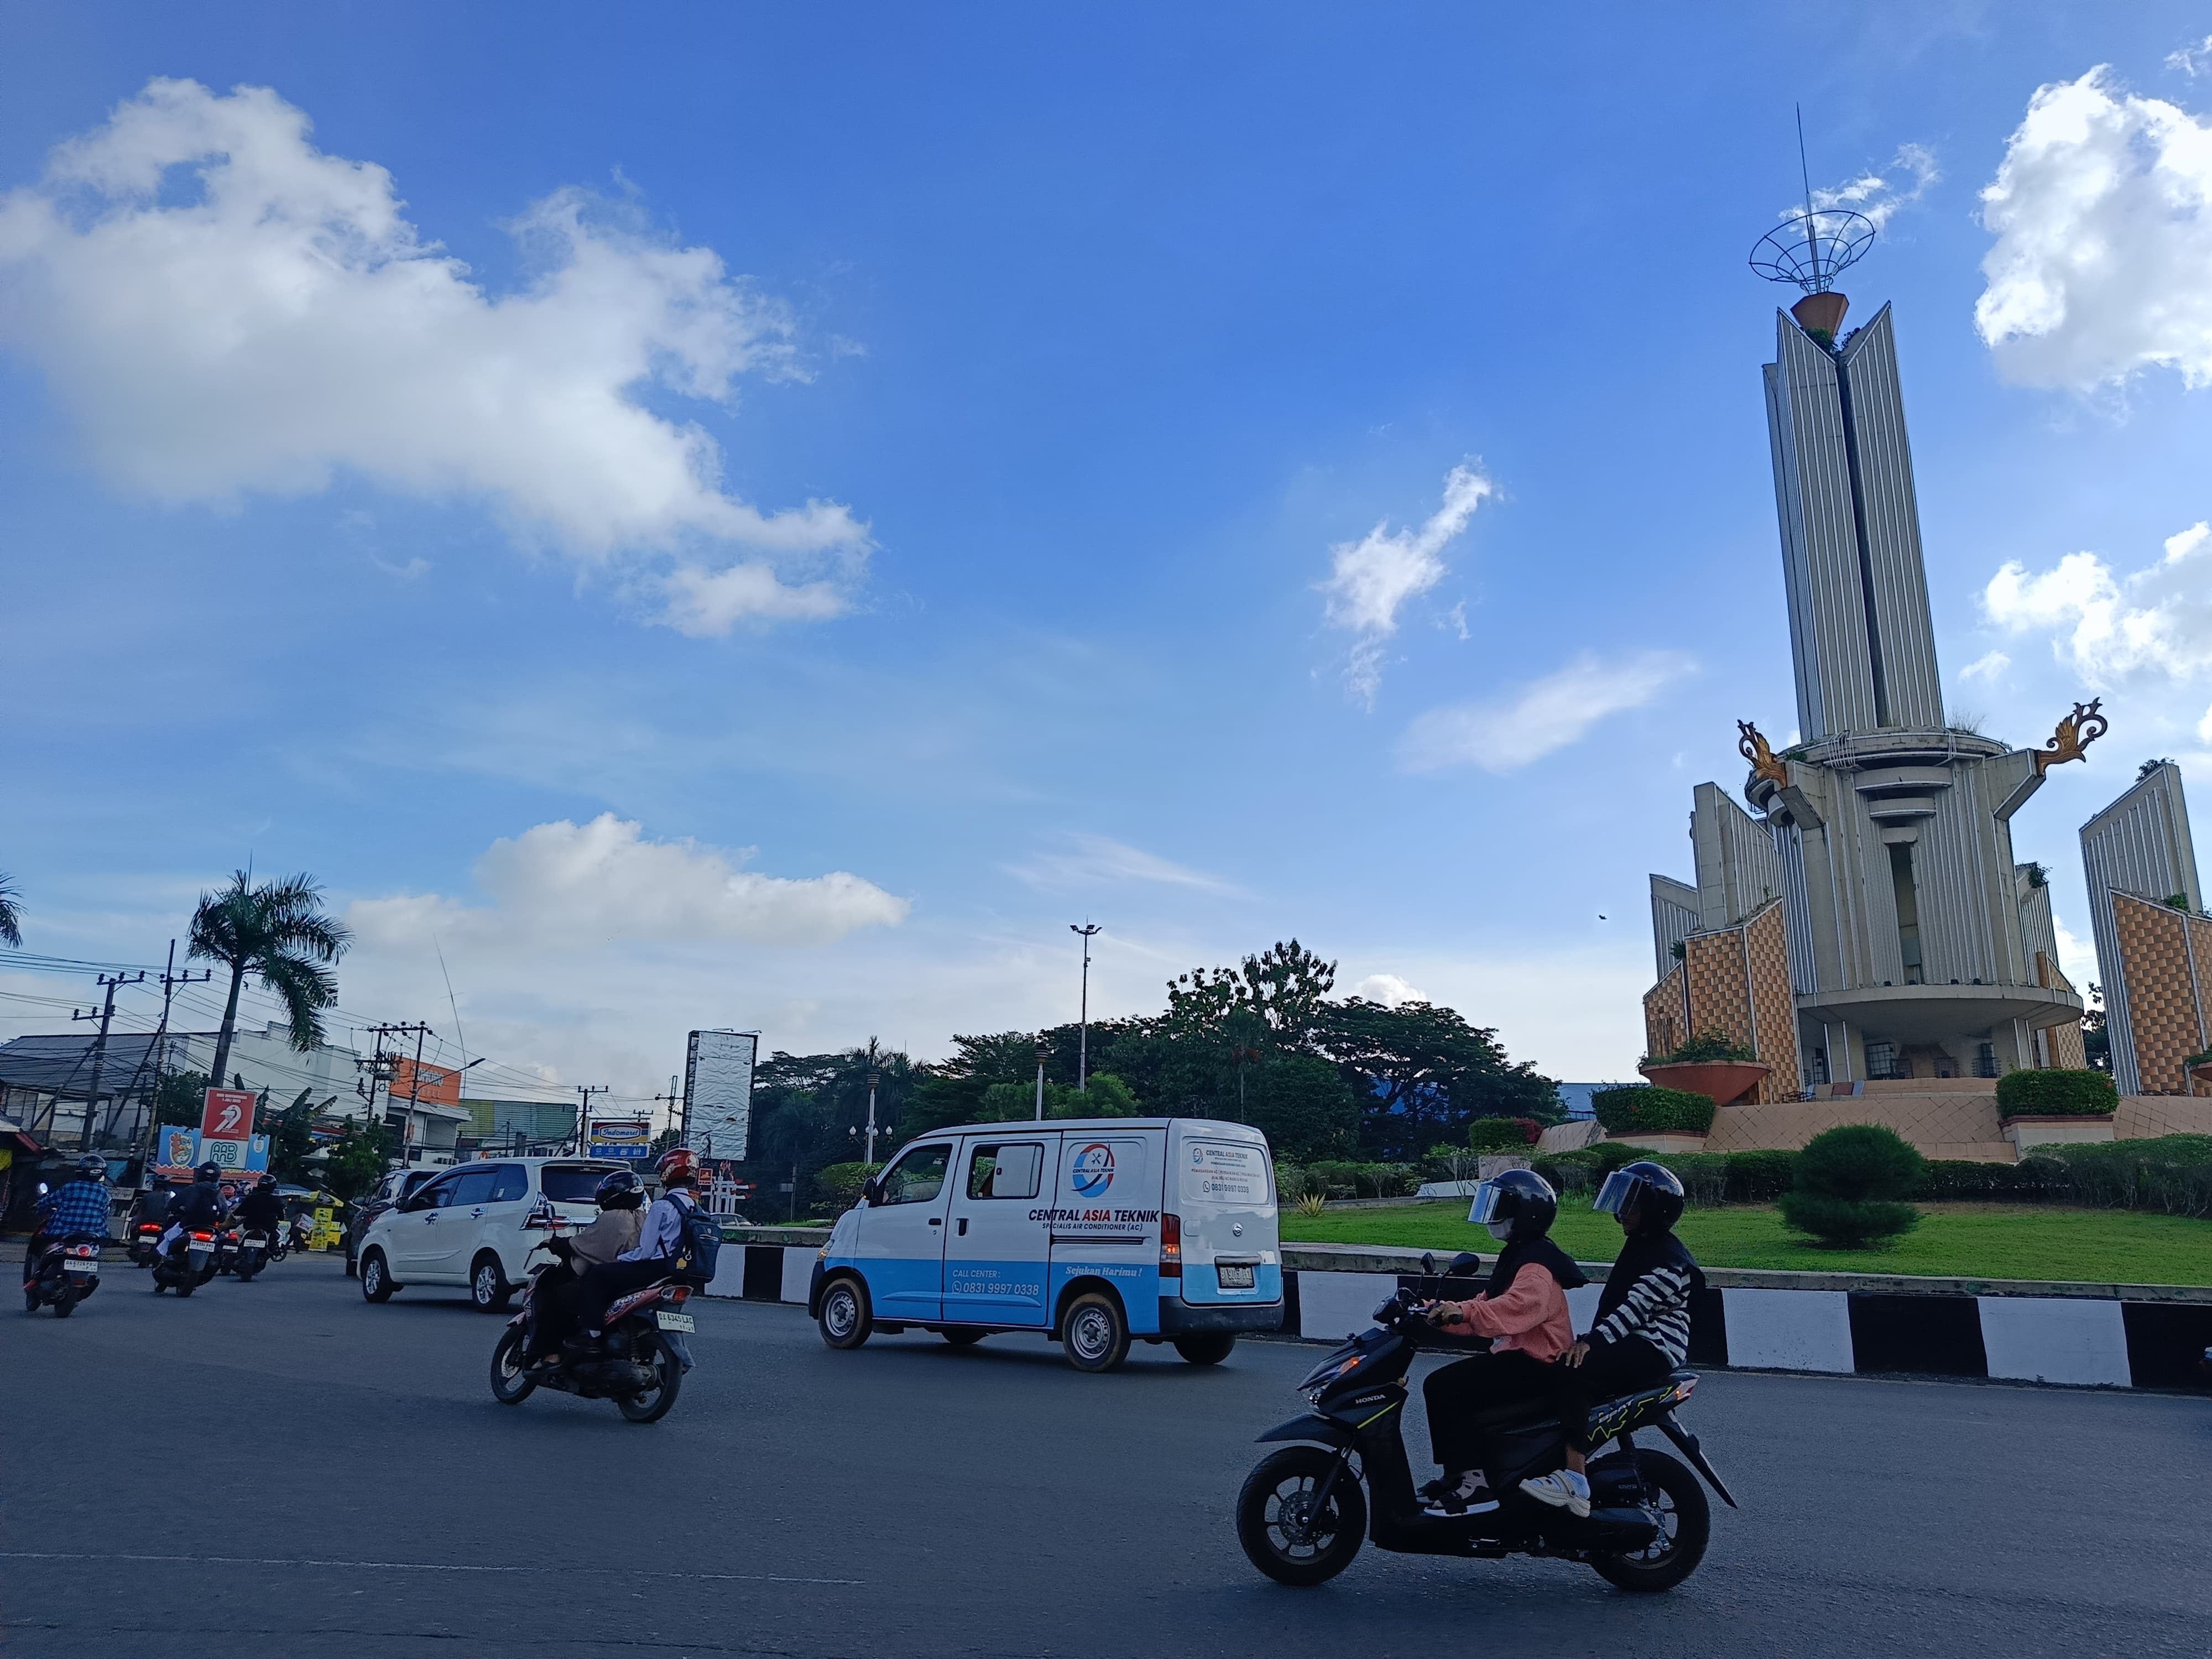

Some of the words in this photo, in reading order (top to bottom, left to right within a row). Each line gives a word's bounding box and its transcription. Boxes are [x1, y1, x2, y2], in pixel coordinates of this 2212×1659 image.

[1224, 1184, 1237, 1192] 9997
[1029, 1209, 1080, 1221] CENTRAL
[1082, 1209, 1110, 1221] ASIA
[1114, 1210, 1160, 1222] TEKNIK
[1127, 1223, 1143, 1232] (AC)
[952, 1269, 969, 1277] CALL
[1066, 1266, 1100, 1276] Sejukan
[1101, 1267, 1137, 1277] Harimu
[1220, 1269, 1225, 1279] B
[963, 1282, 985, 1293] 0831
[987, 1283, 1013, 1294] 9997
[1014, 1284, 1039, 1296] 0338
[1355, 1394, 1386, 1404] HONDA
